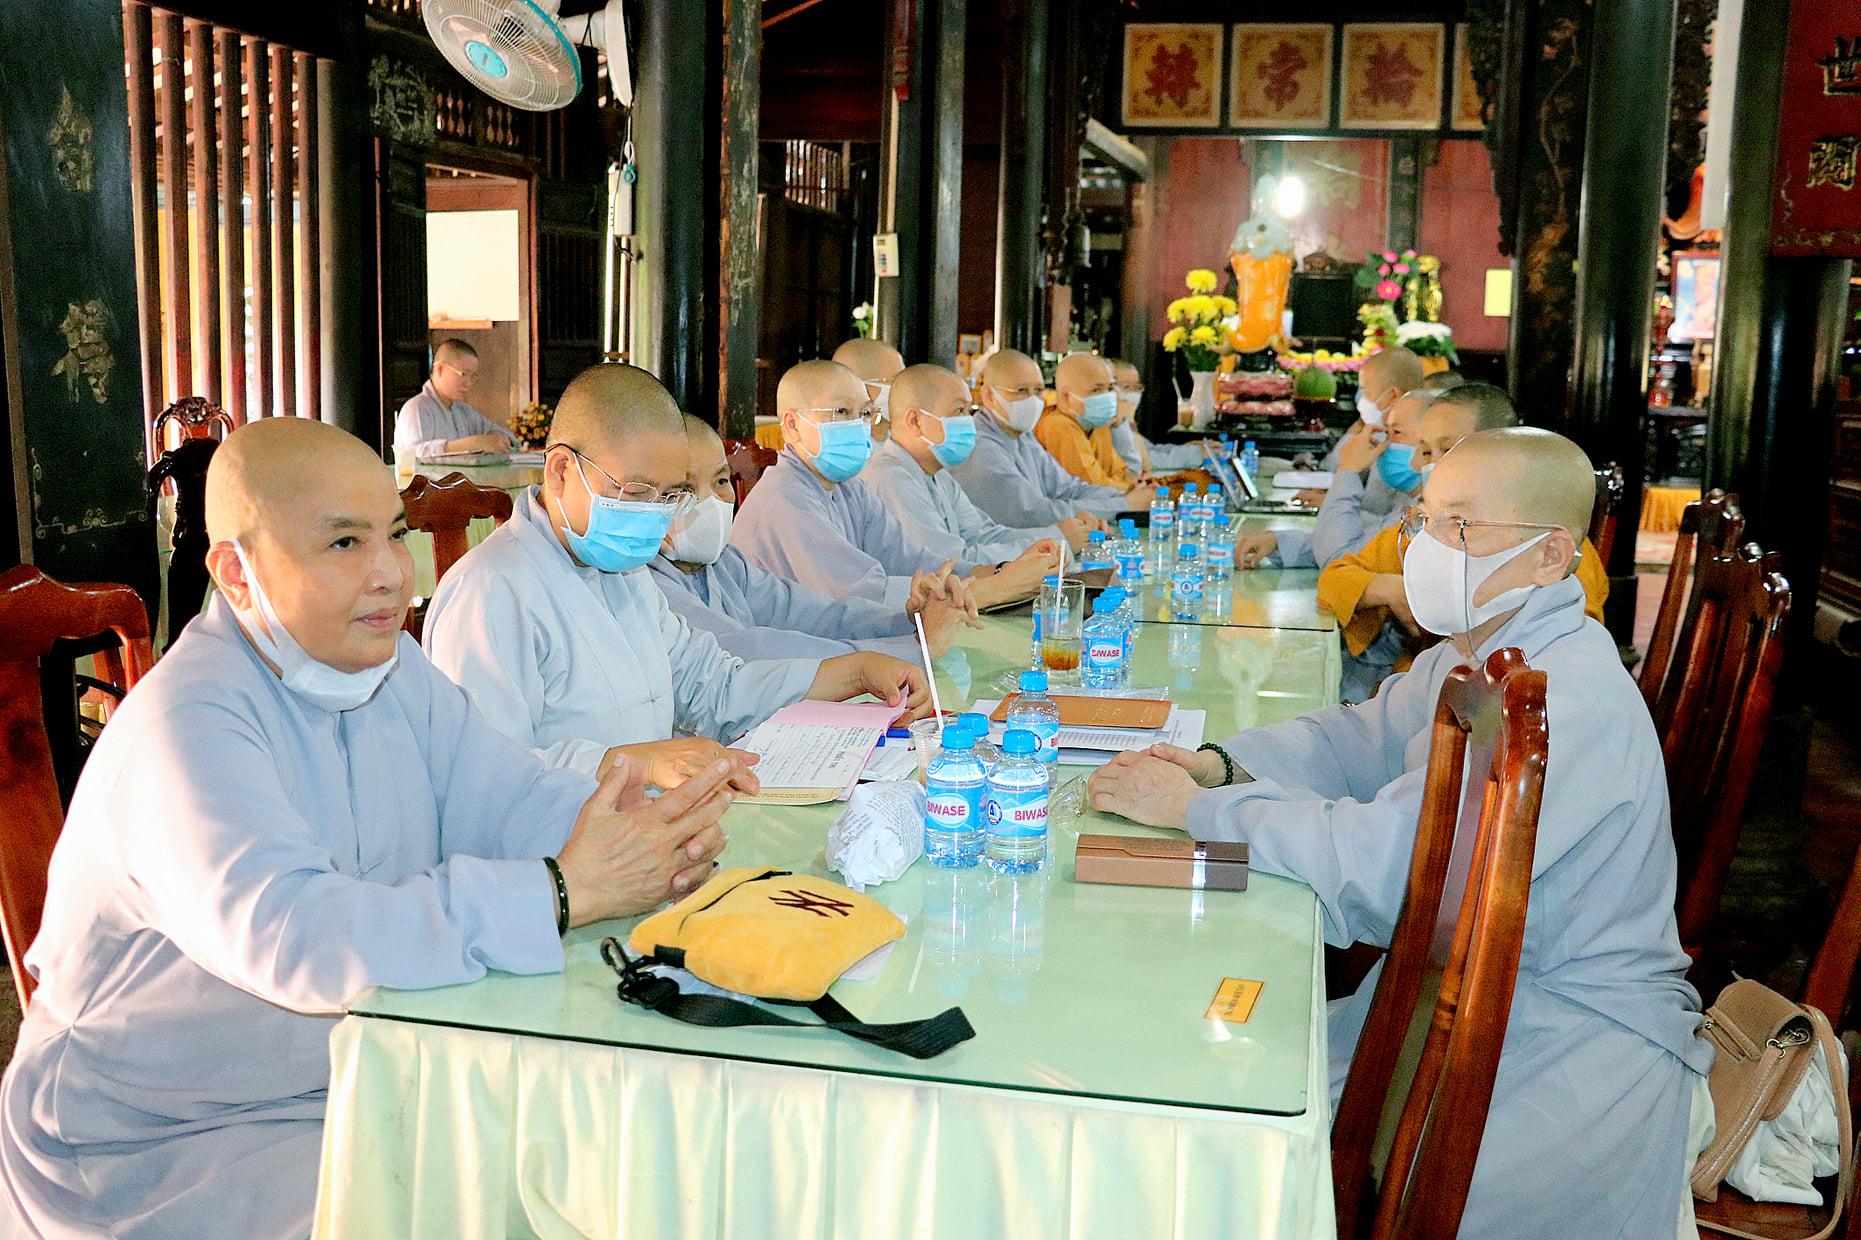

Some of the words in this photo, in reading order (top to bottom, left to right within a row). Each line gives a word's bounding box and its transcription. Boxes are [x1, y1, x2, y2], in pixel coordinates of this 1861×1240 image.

[1091, 649, 1120, 657] BIWASE
[927, 800, 966, 816] BIWASE
[1014, 805, 1048, 821] BIWAS
